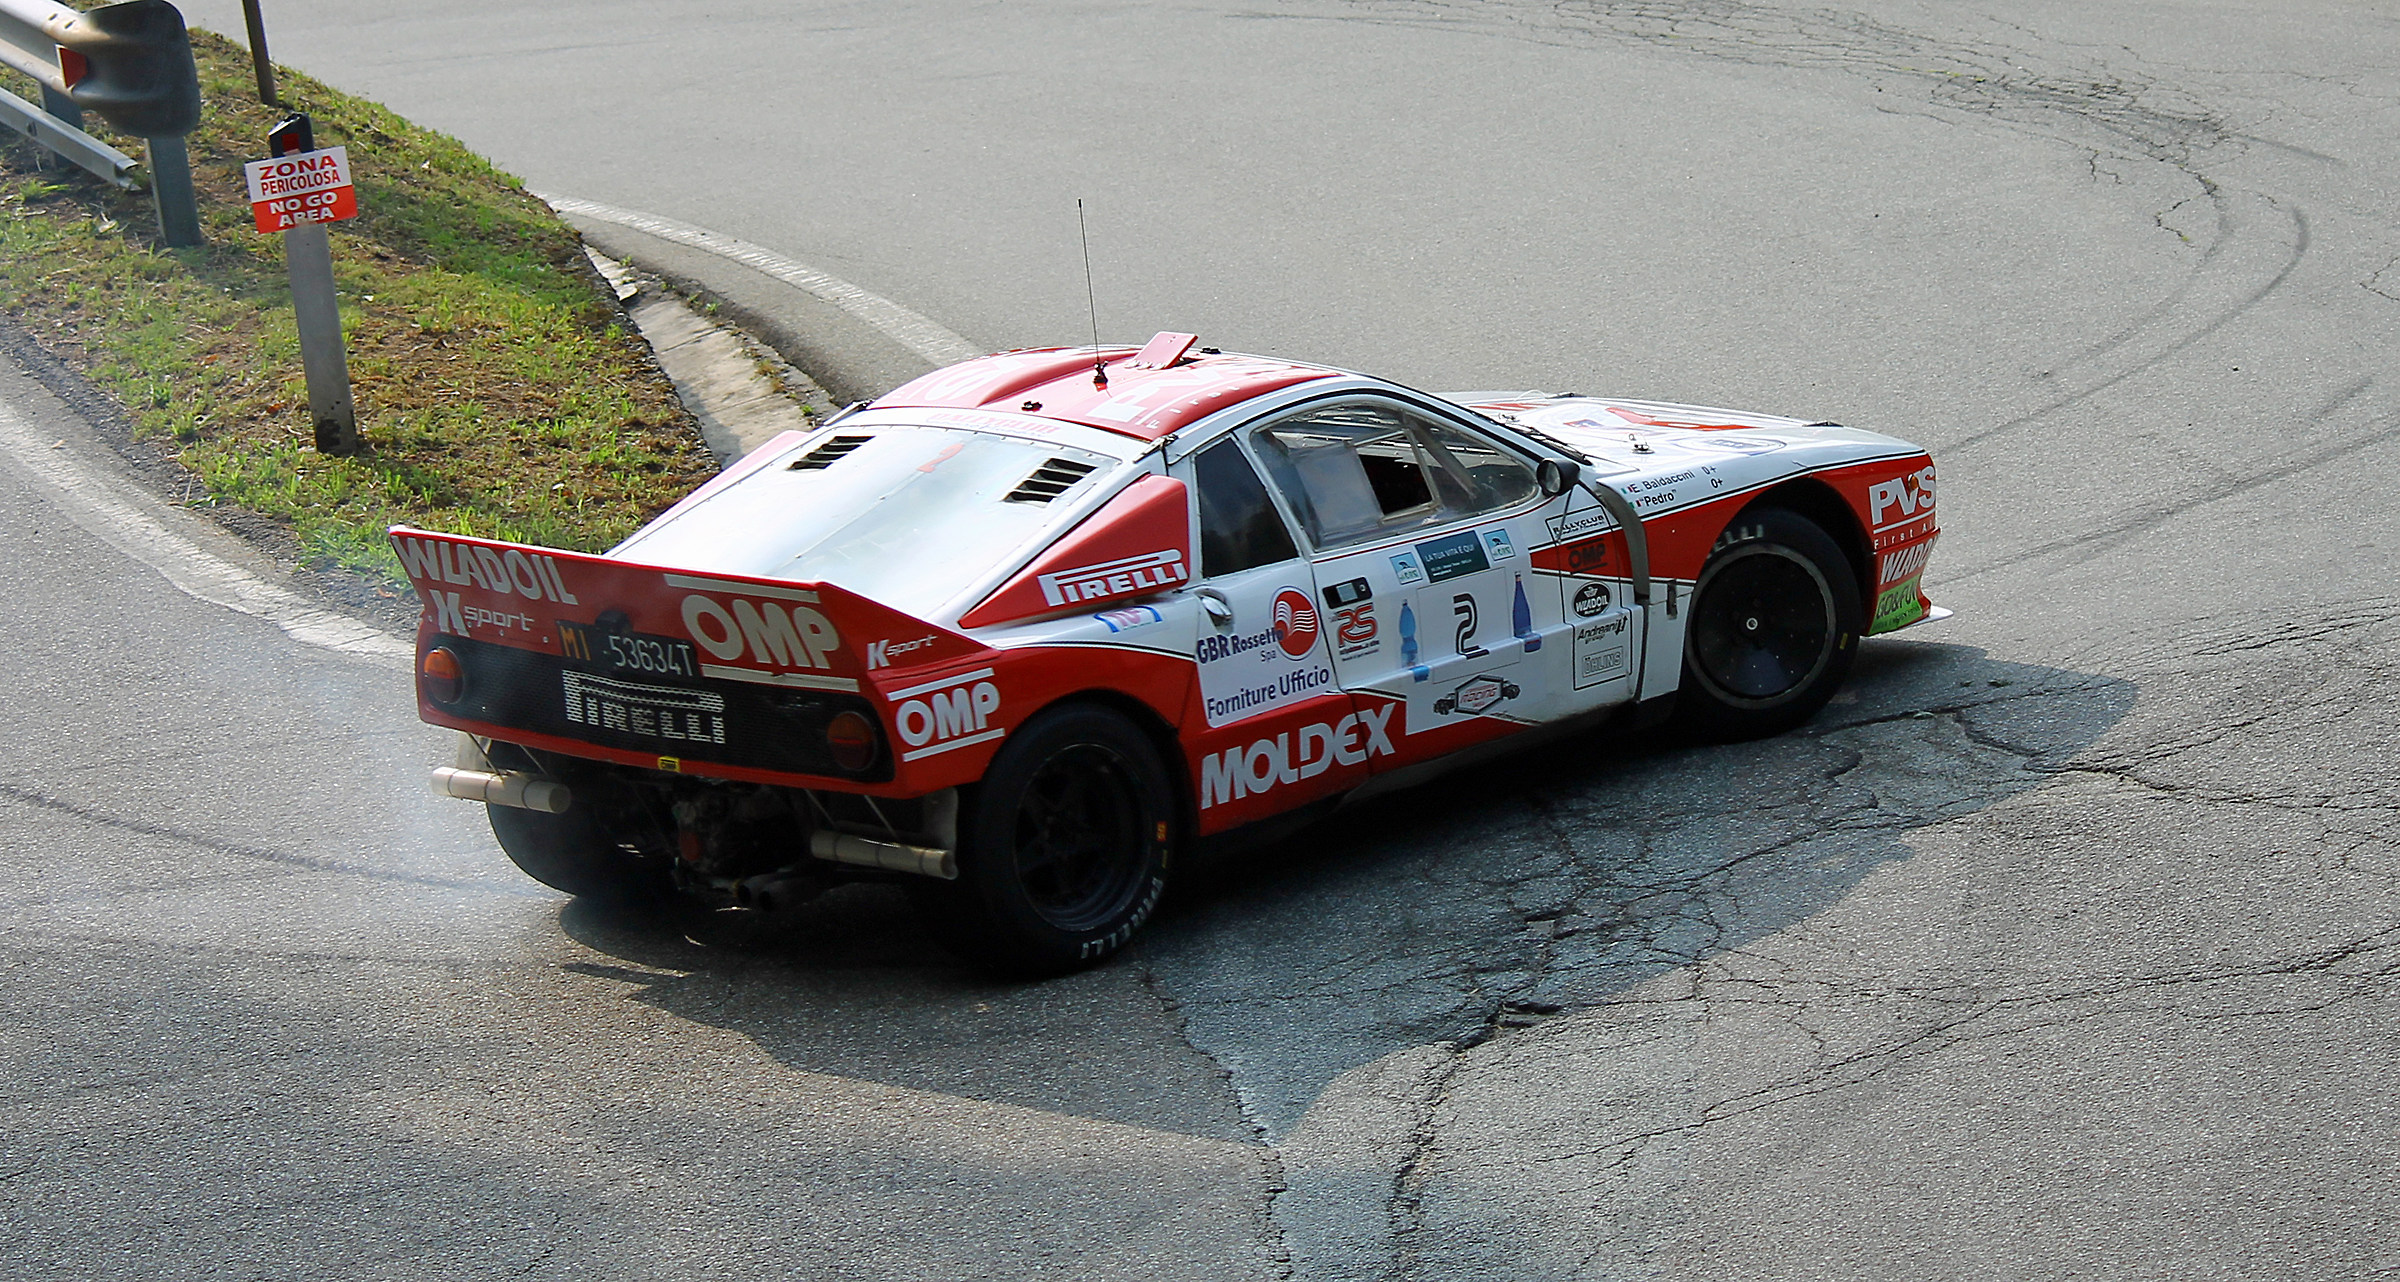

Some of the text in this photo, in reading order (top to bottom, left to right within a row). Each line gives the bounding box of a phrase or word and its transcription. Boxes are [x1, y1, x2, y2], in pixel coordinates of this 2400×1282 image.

[259, 155, 338, 180] ZONA
[261, 169, 341, 196] PERICOLOSA
[269, 191, 338, 214] NO GO
[279, 207, 335, 227] AREA
[1642, 470, 1696, 490] Baldaccini
[1869, 465, 1937, 525] PVS
[392, 535, 579, 606] WLADOIL
[1037, 548, 1189, 607] PIRELLI
[1568, 543, 1606, 569] OMP
[1453, 593, 1490, 660] 2
[1575, 594, 1609, 612] WLADOIL
[559, 625, 693, 676] MI 53634T
[681, 594, 840, 670] OMP
[1196, 626, 1285, 664] GBR Rossetto
[1260, 649, 1277, 663] Spa
[562, 669, 726, 745] PIRELLI
[896, 681, 1001, 747] OMP
[1207, 665, 1330, 719] Forniture Ufficio
[1201, 702, 1397, 810] MOLDEX
